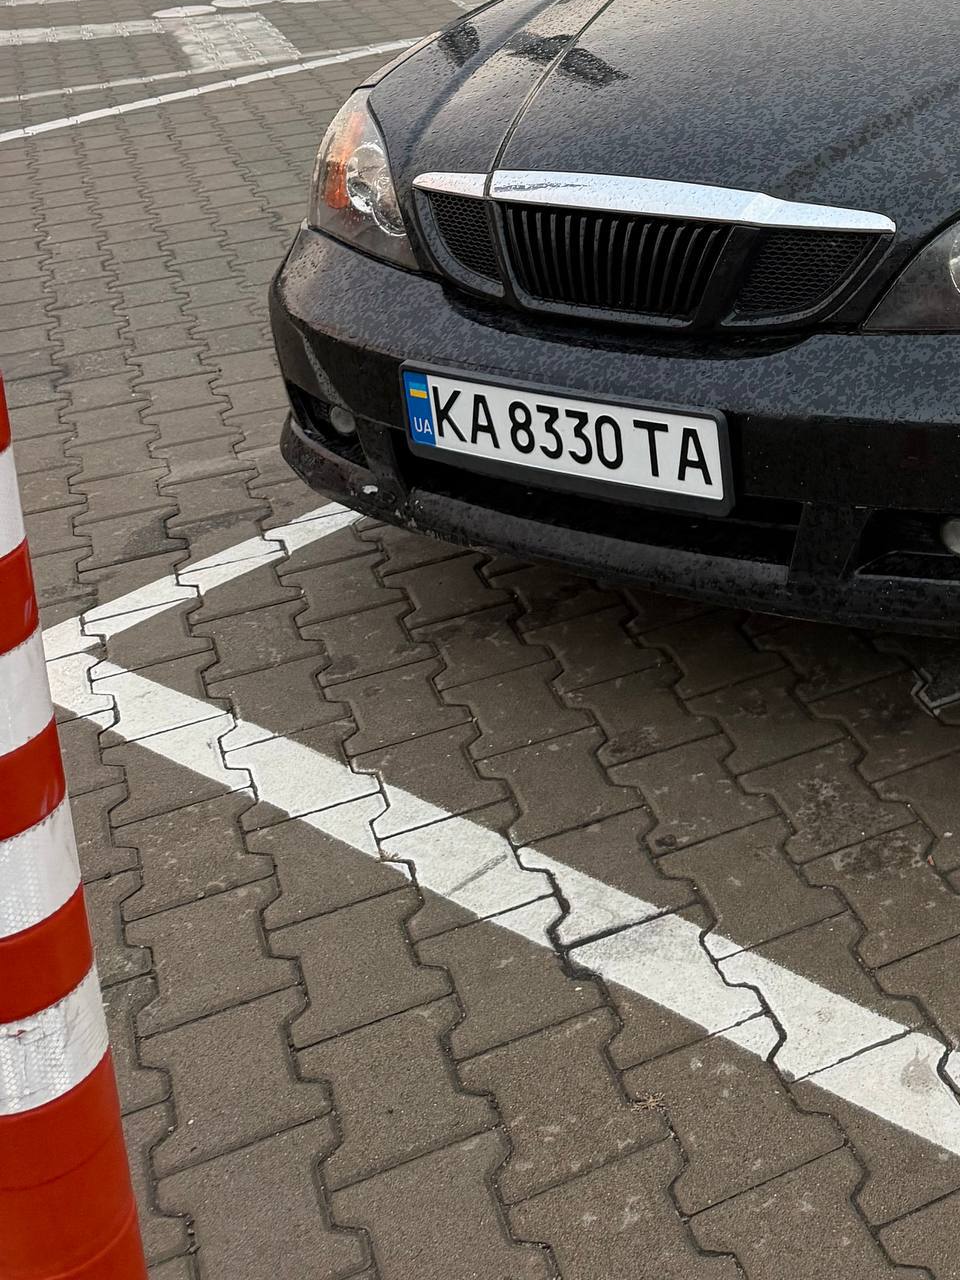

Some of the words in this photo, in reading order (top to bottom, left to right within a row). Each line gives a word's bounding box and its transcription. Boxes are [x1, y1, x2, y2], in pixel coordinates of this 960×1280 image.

[413, 416, 433, 436] UA
[432, 385, 501, 449] KA
[508, 400, 624, 471] 8330
[632, 418, 713, 486] TA
